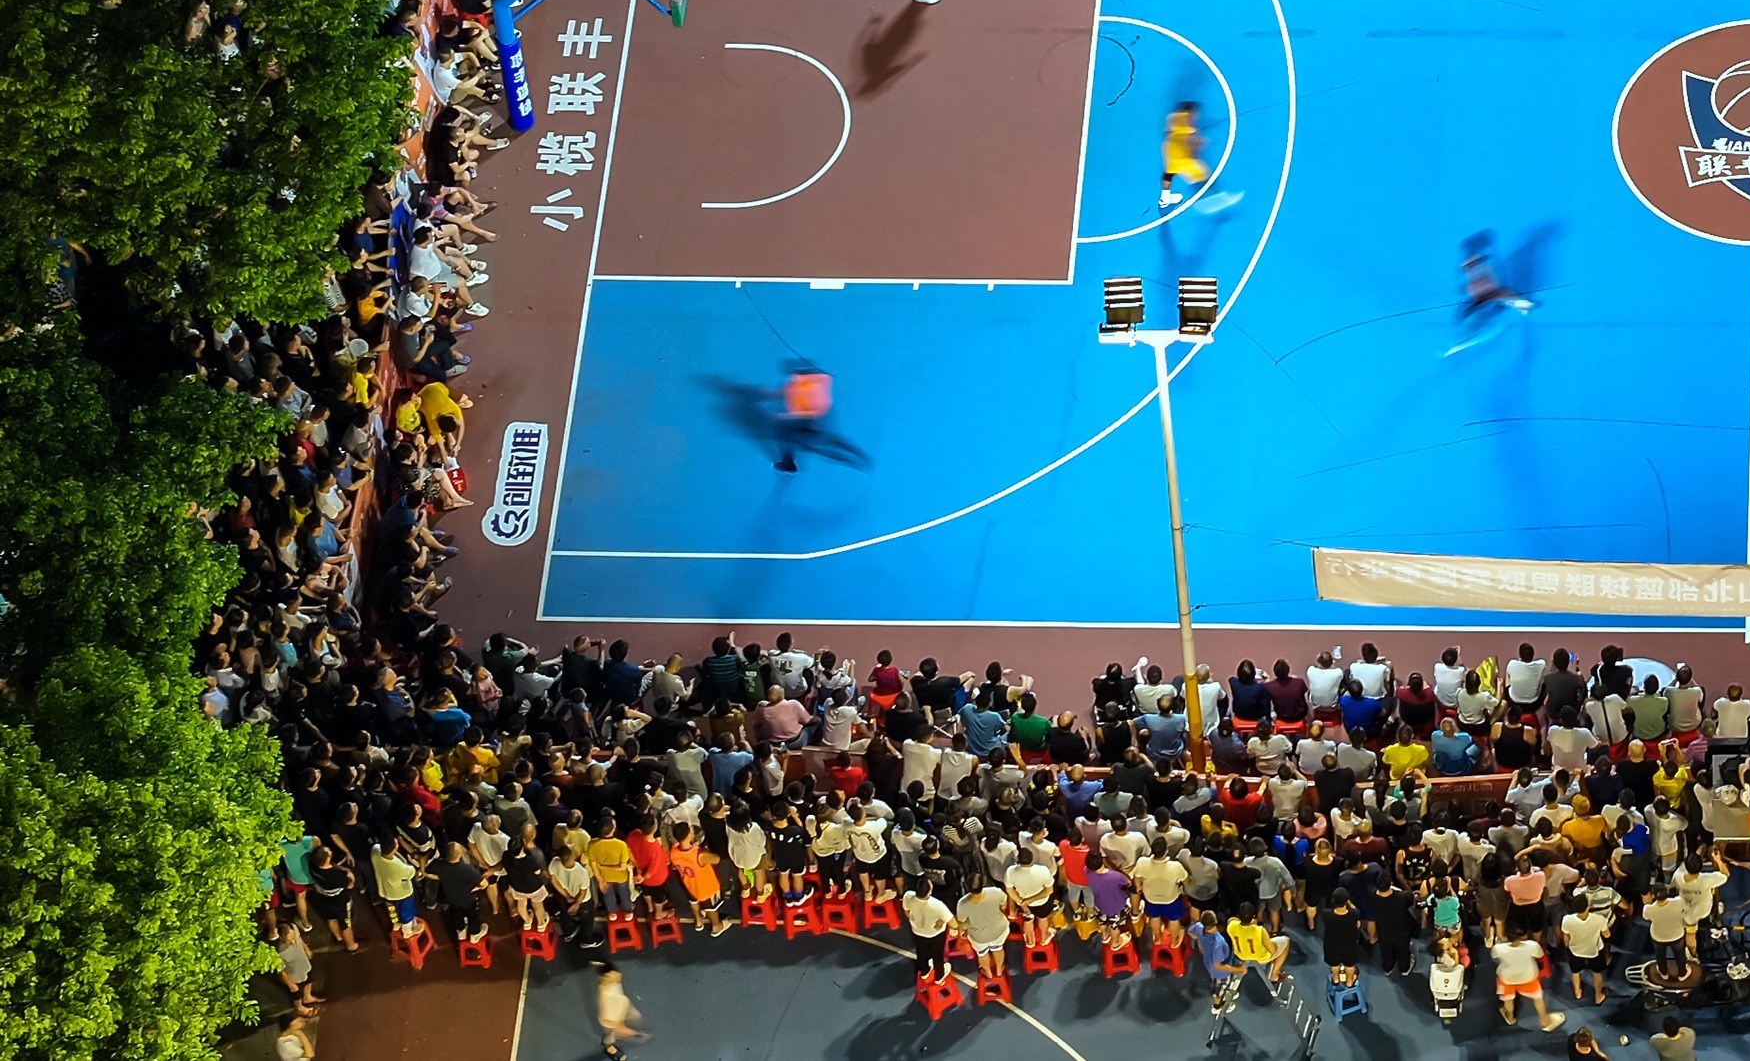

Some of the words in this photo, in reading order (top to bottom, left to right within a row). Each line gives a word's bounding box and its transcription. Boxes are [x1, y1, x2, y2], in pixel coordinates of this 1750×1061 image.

[530, 17, 613, 232] 小榄联丰
[1233, 935, 1256, 955] 11
